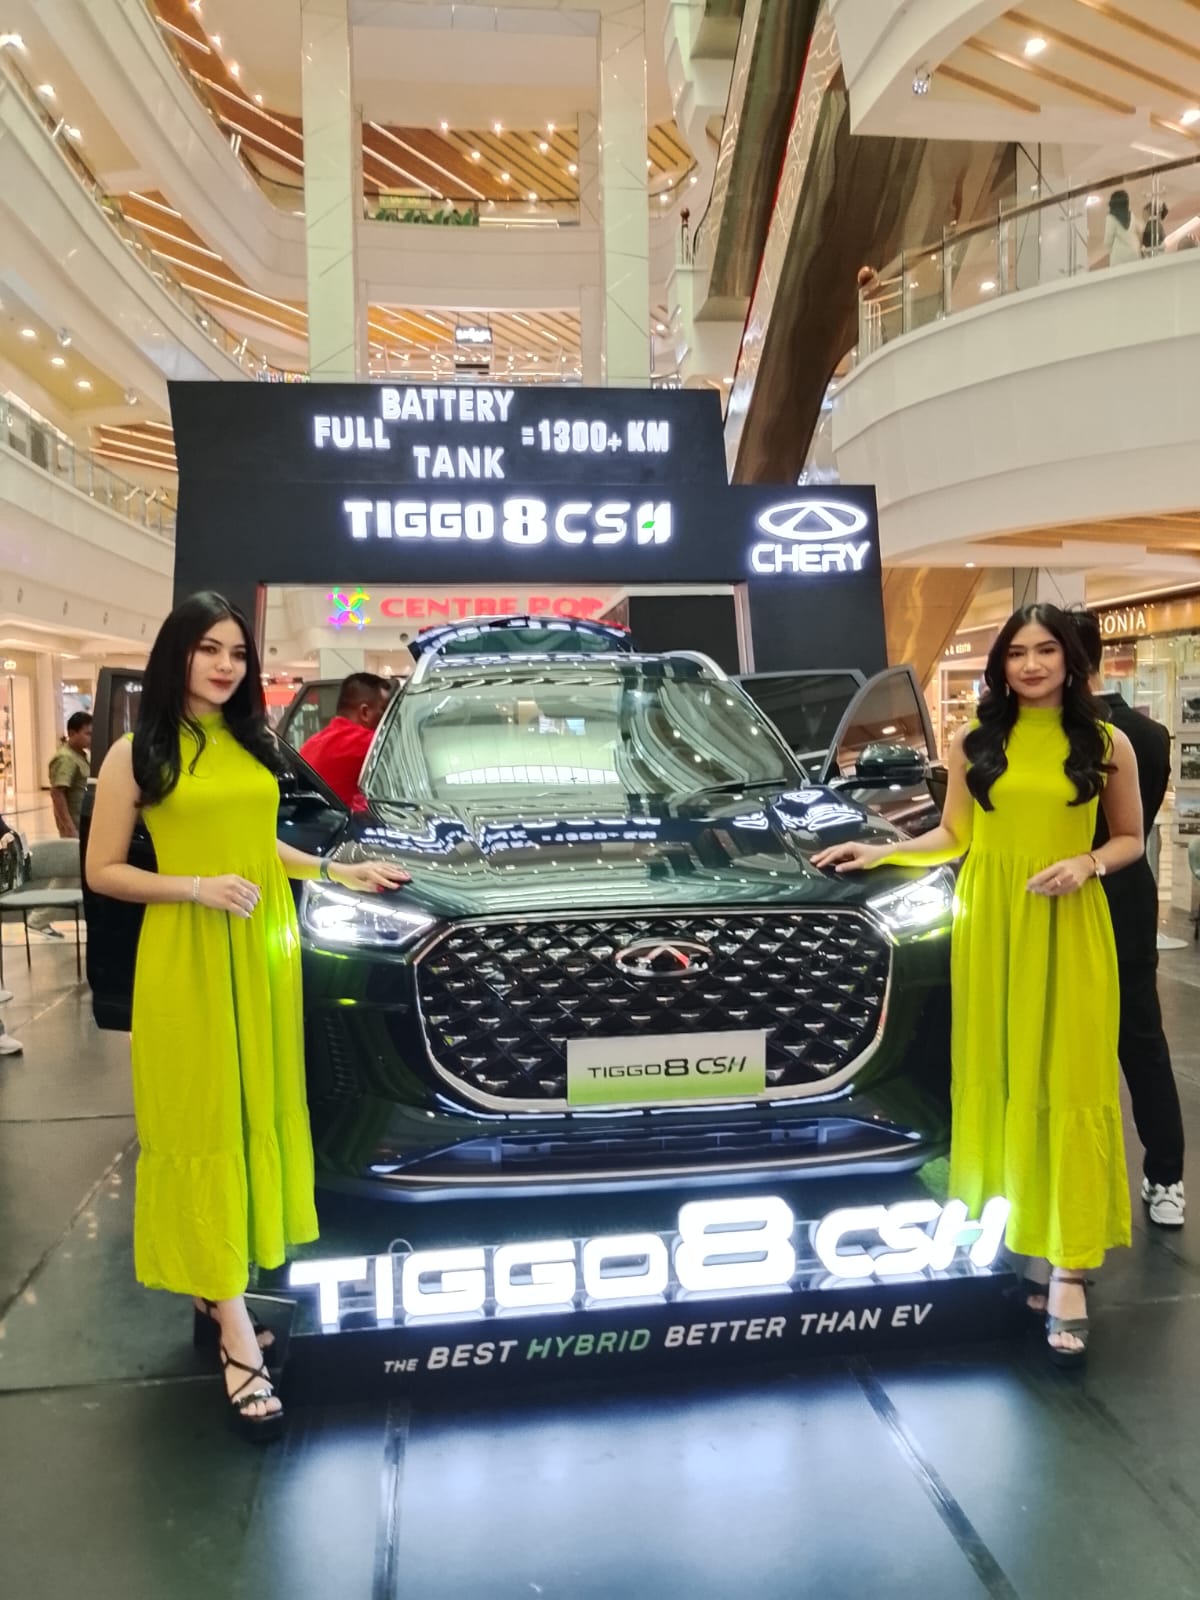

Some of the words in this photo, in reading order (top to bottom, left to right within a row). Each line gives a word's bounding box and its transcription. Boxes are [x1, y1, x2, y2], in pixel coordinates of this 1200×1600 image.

[381, 387, 514, 422] BATTERY
[314, 416, 391, 449] FULL
[627, 420, 669, 452] KM
[413, 445, 505, 478] TANK
[751, 541, 871, 573] CHERY
[380, 597, 517, 618] CENTRE
[695, 1056, 747, 1075] CSH
[815, 1196, 1011, 1280] CSH
[384, 1358, 418, 1374] THE
[427, 1340, 518, 1371] BEST
[526, 1329, 651, 1361] HYBRID
[664, 1316, 787, 1348] BETTER
[800, 1308, 882, 1336] THAN
[891, 1303, 933, 1328] EV
